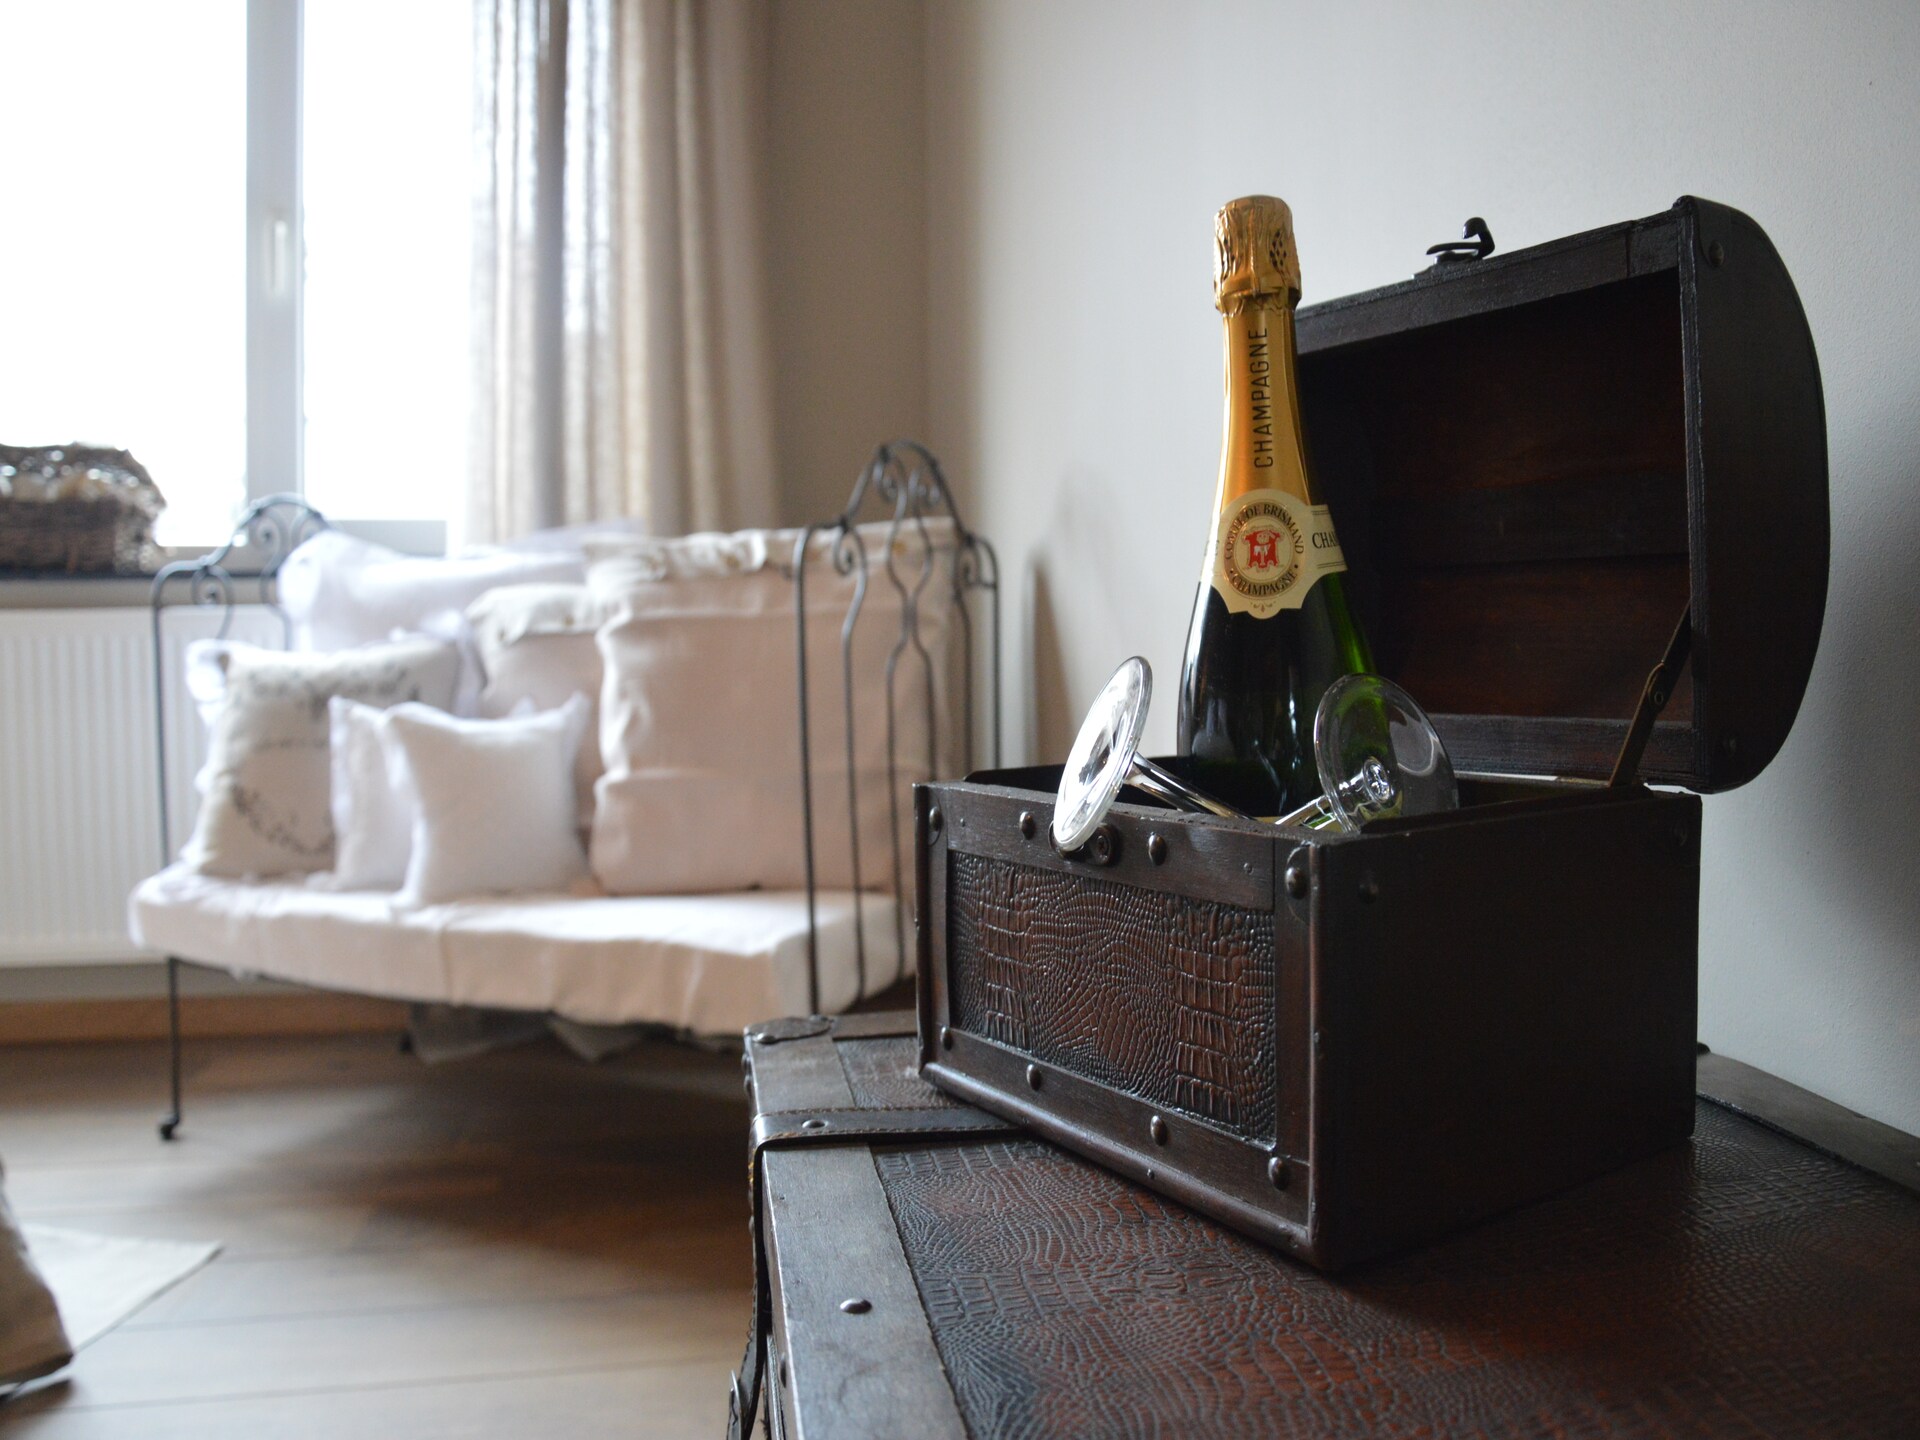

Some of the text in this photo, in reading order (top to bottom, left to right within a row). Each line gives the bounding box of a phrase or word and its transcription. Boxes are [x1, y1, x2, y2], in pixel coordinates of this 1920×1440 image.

[1248, 328, 1273, 468] CHAMPAGNE
[1263, 503, 1304, 554] BRISMAND
[1232, 571, 1297, 596] CHAMPAGNE
